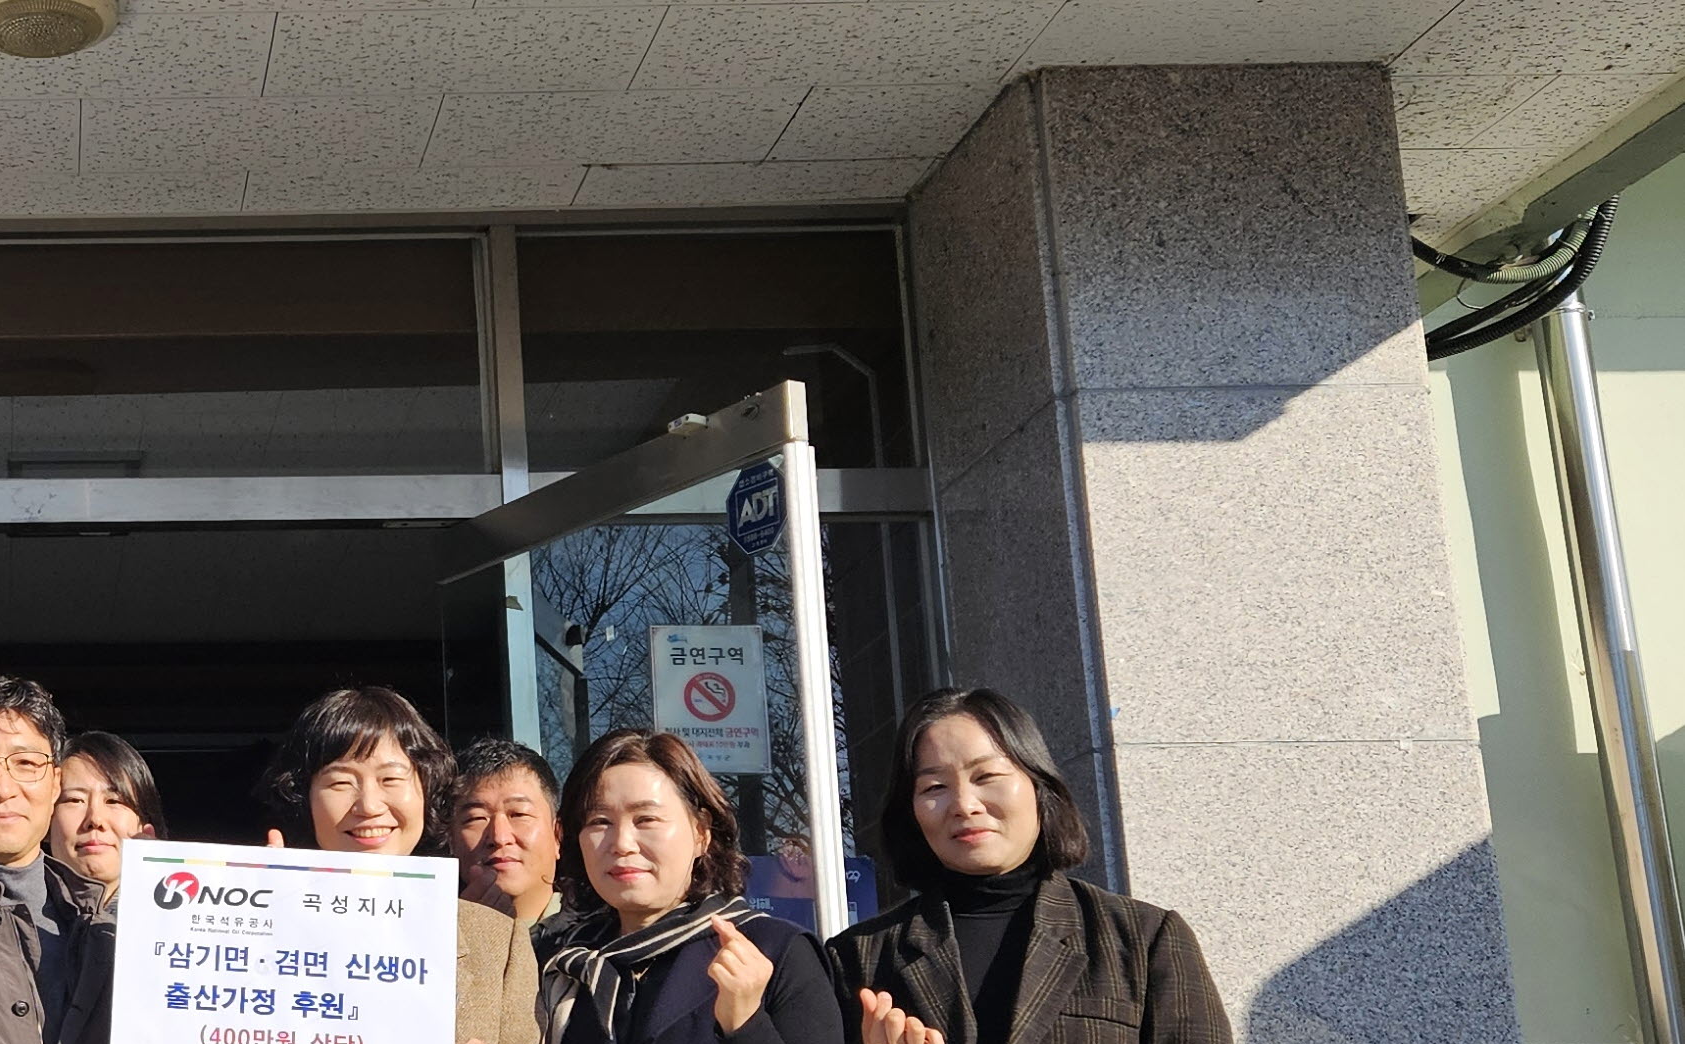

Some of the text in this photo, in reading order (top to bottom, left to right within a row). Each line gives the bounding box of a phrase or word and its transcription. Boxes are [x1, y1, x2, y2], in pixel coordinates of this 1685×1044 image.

[737, 484, 778, 529] ADT
[669, 647, 744, 666] 금연구역
[302, 892, 405, 919] 곡성지사
[345, 952, 428, 985] 신생아
[164, 981, 360, 1021] 출산가정 후원』
